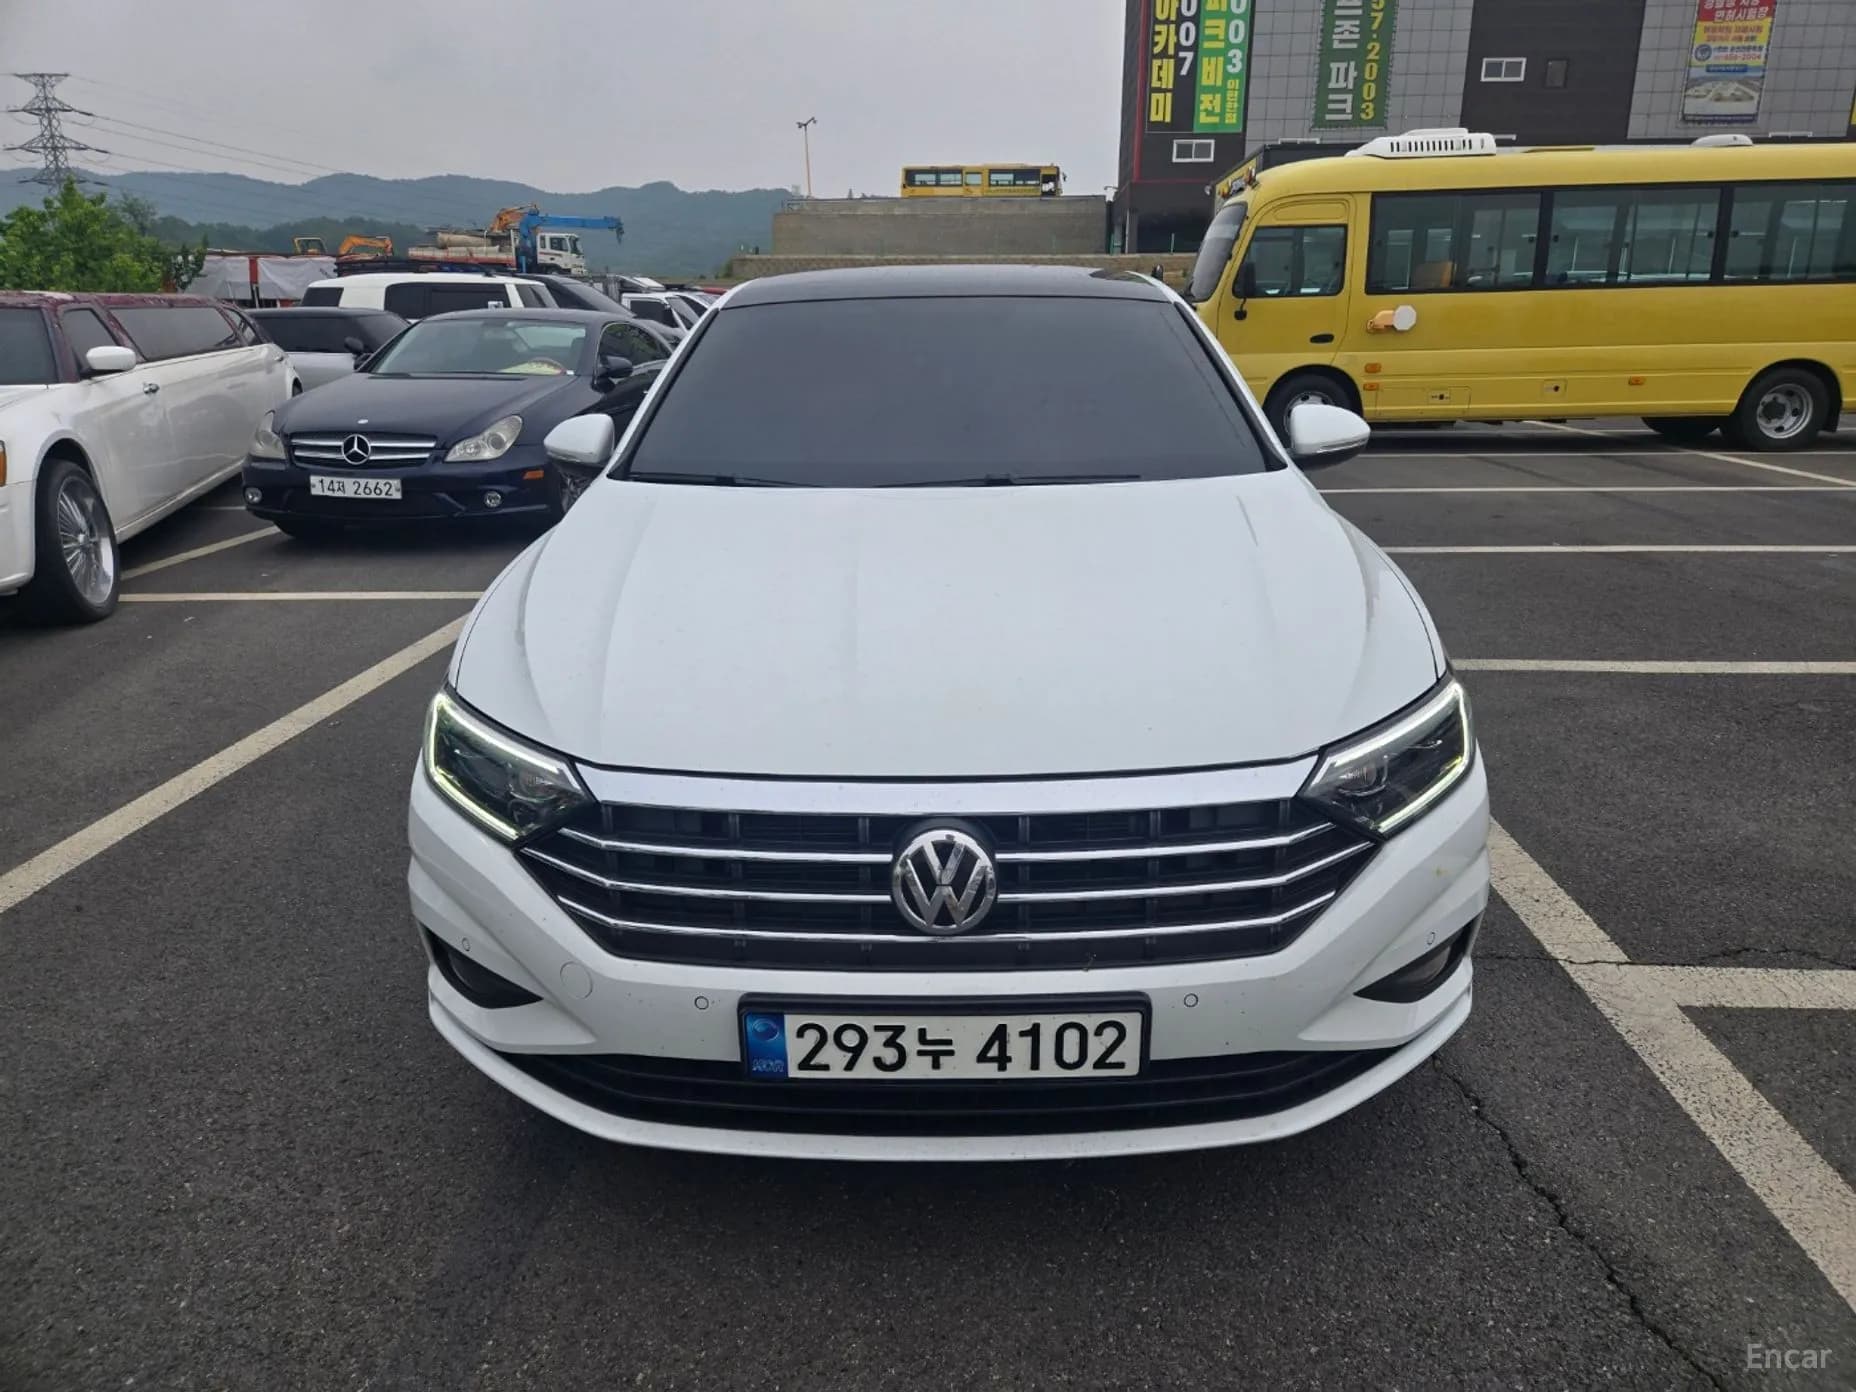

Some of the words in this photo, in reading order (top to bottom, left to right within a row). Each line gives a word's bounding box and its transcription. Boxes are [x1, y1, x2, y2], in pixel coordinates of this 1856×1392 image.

[353, 480, 393, 496] 2662
[795, 1022, 955, 1072] 293누
[976, 1020, 1127, 1071] 4102
